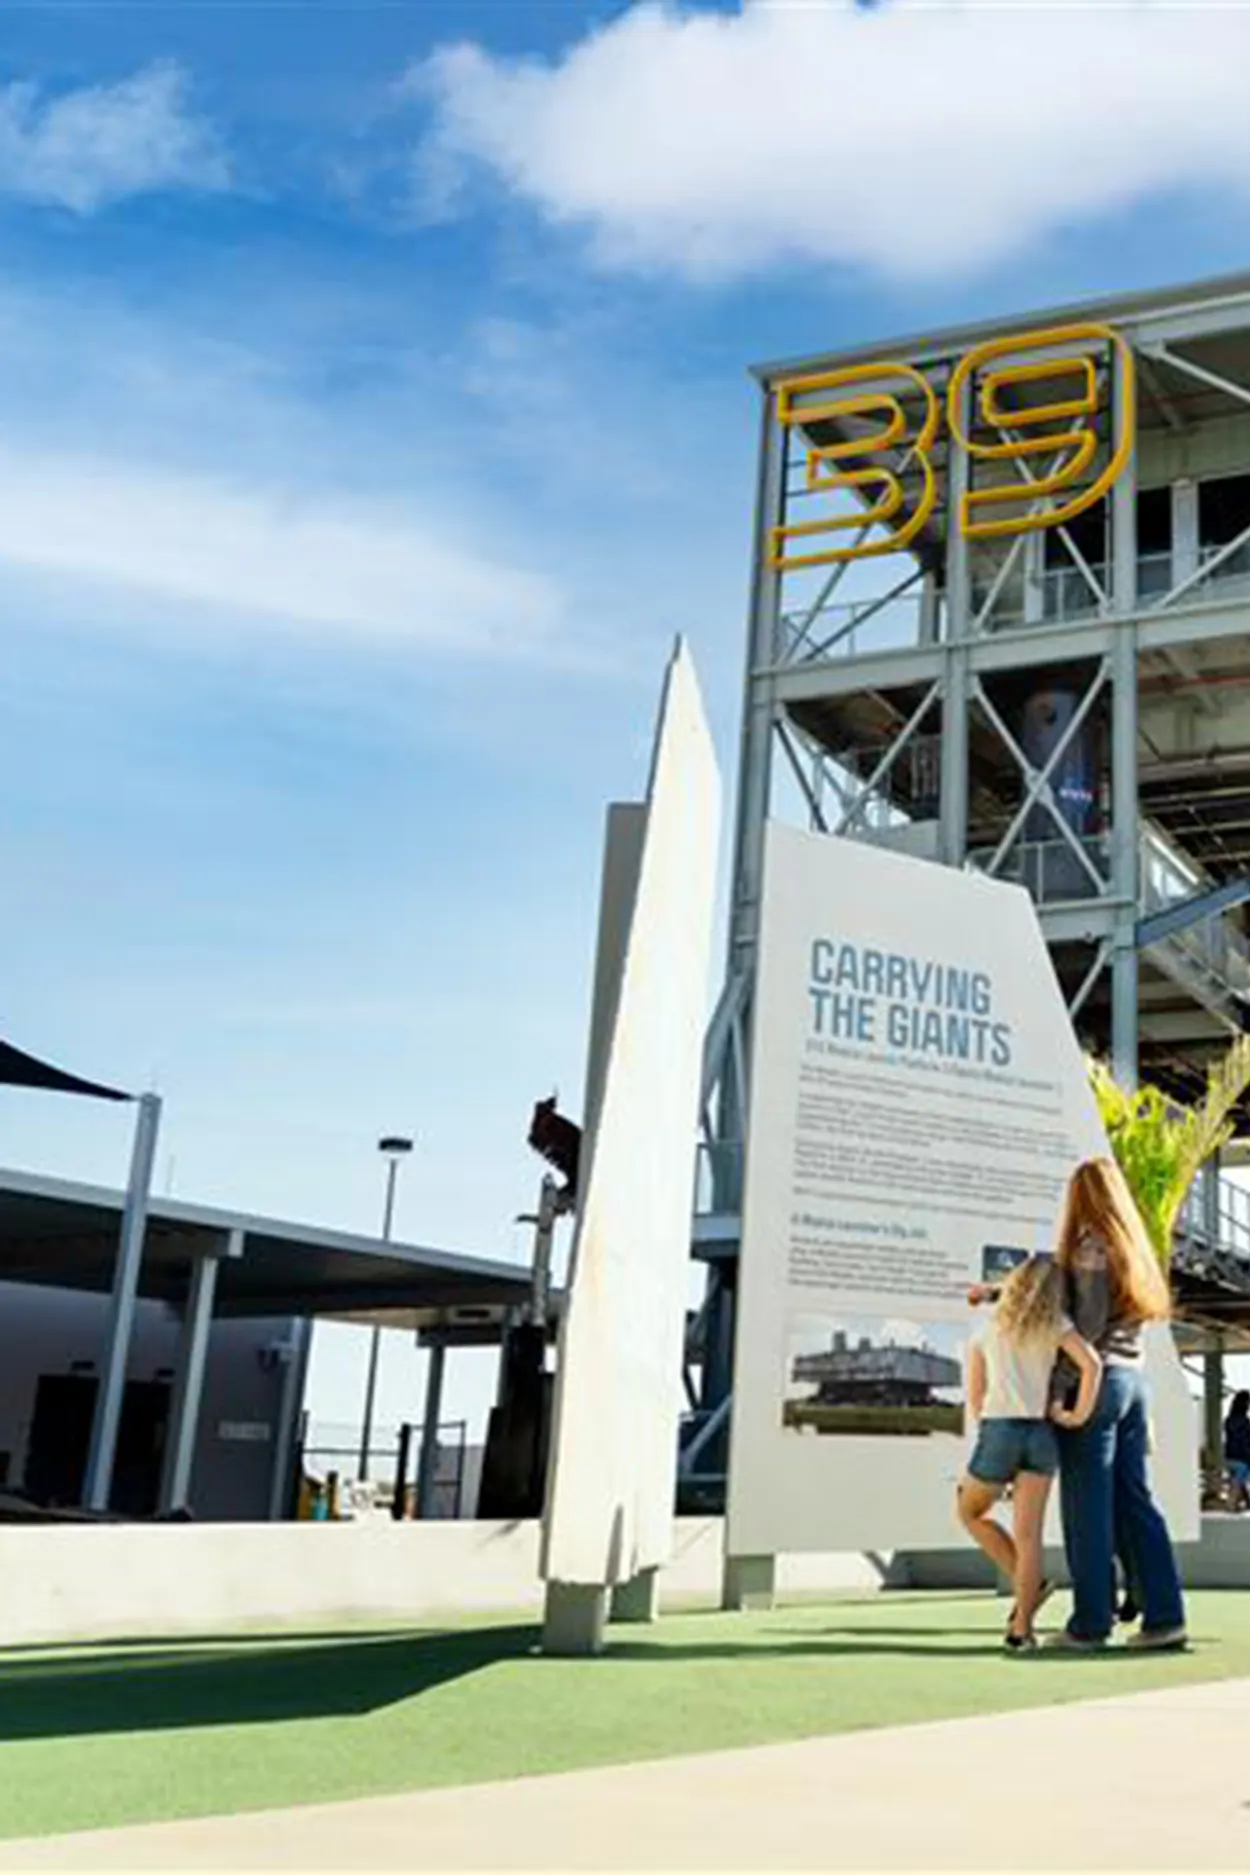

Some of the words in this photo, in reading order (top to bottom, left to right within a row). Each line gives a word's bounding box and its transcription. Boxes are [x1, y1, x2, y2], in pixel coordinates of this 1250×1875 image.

[770, 323, 1135, 570] 39
[810, 938, 992, 1015] CARRYING
[808, 987, 876, 1042] THE
[886, 1003, 1012, 1067] GIANTS
